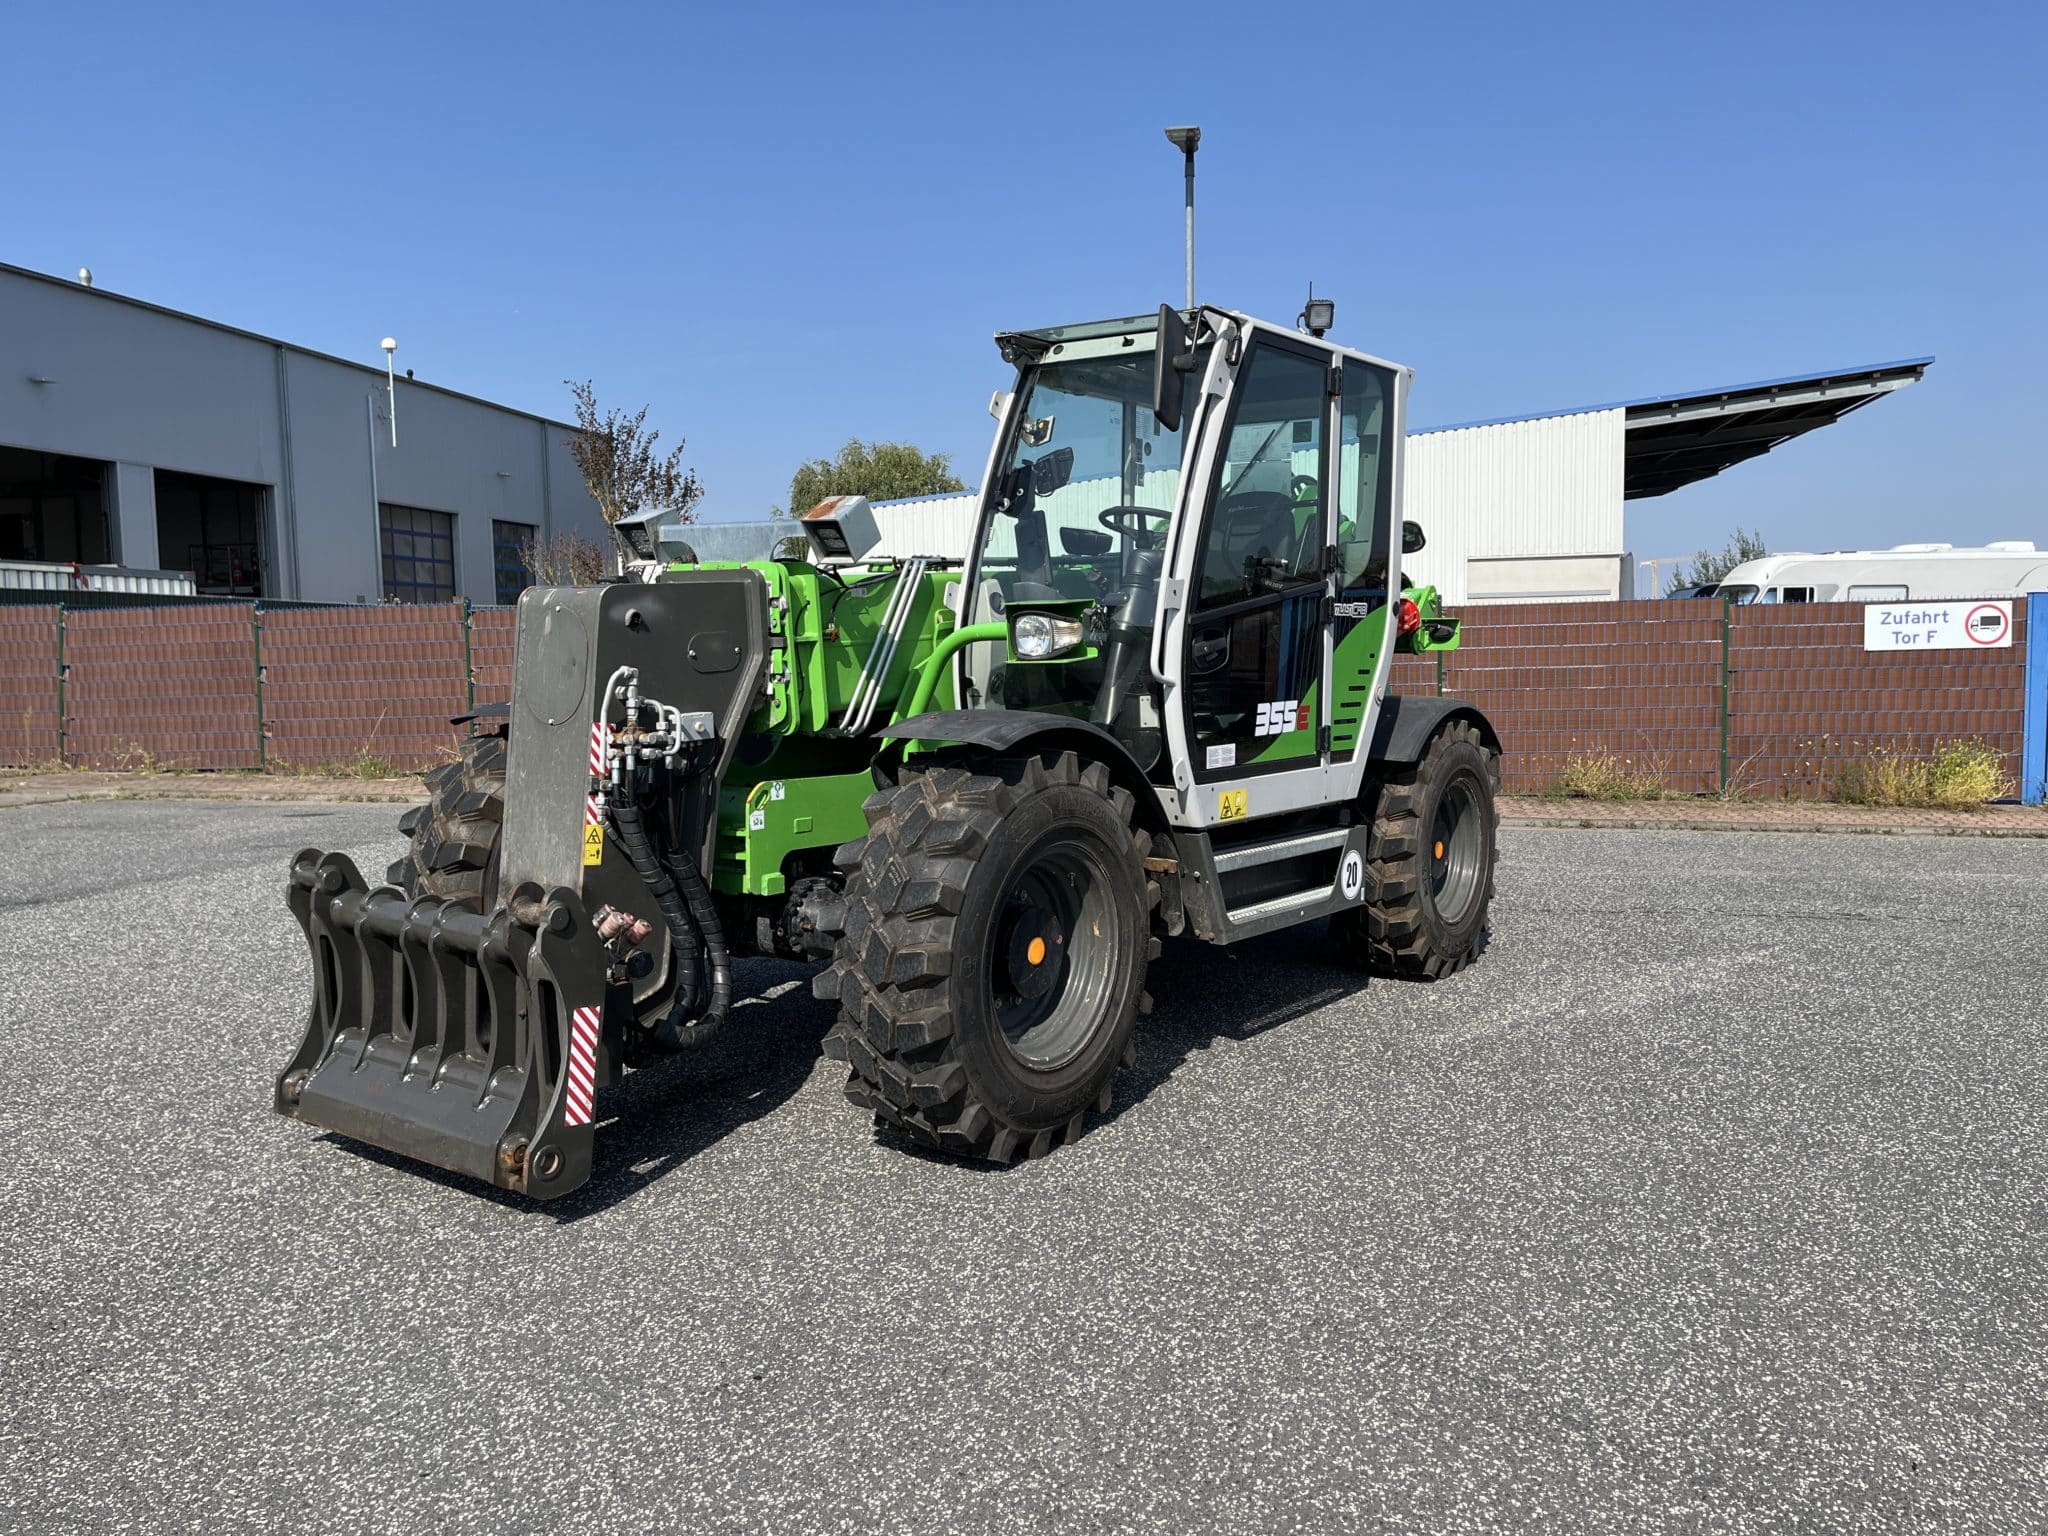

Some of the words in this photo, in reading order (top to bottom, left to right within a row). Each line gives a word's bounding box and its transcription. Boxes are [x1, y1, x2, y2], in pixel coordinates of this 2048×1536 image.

[1880, 610, 1949, 625] Zufahrt
[1892, 631, 1920, 644] Tor
[1927, 630, 1937, 644] F
[1255, 700, 1311, 736] 355E
[1346, 861, 1358, 888] 20
